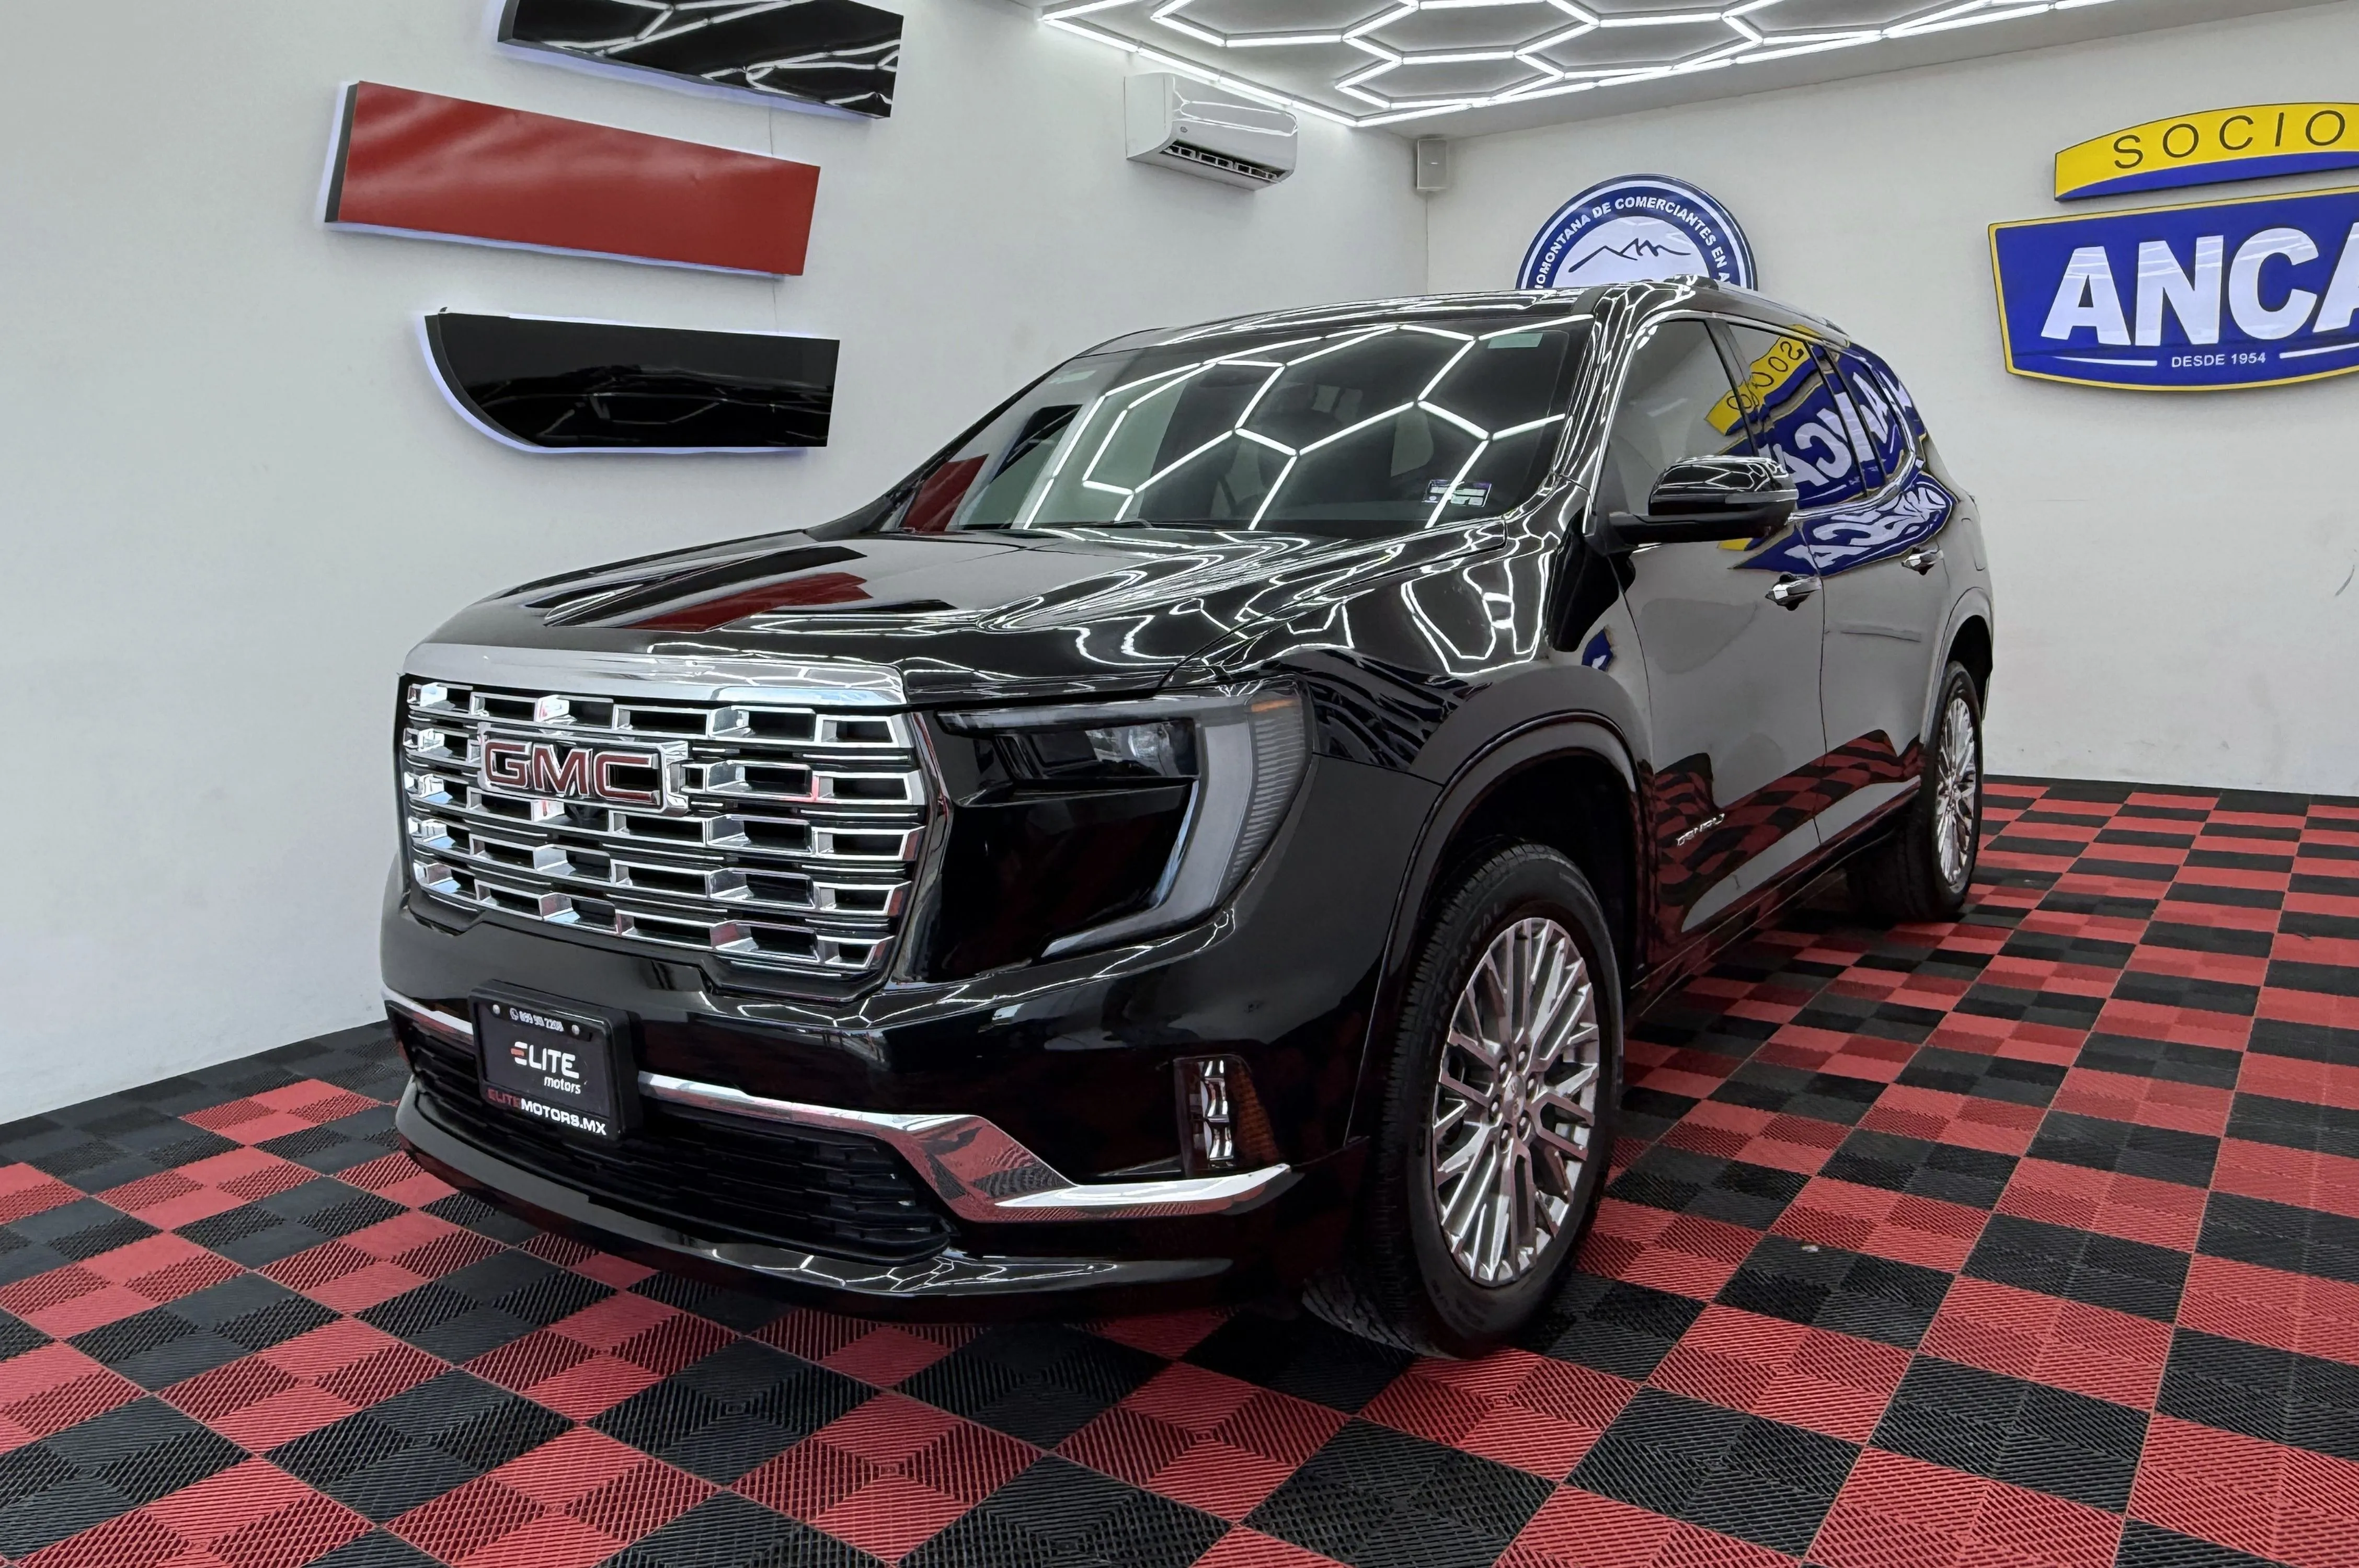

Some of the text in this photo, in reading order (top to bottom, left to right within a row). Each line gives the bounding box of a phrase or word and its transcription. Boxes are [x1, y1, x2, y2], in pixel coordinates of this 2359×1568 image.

[2114, 110, 2345, 169] SOCIO
[1592, 202, 1611, 219] DE
[1614, 196, 1716, 246] COMERCIANTES
[1711, 246, 1727, 268] EN
[2171, 352, 2266, 367] DESDE 1954
[485, 739, 660, 805] GMC
[510, 1041, 579, 1079] ELITE
[544, 1076, 581, 1094] motors
